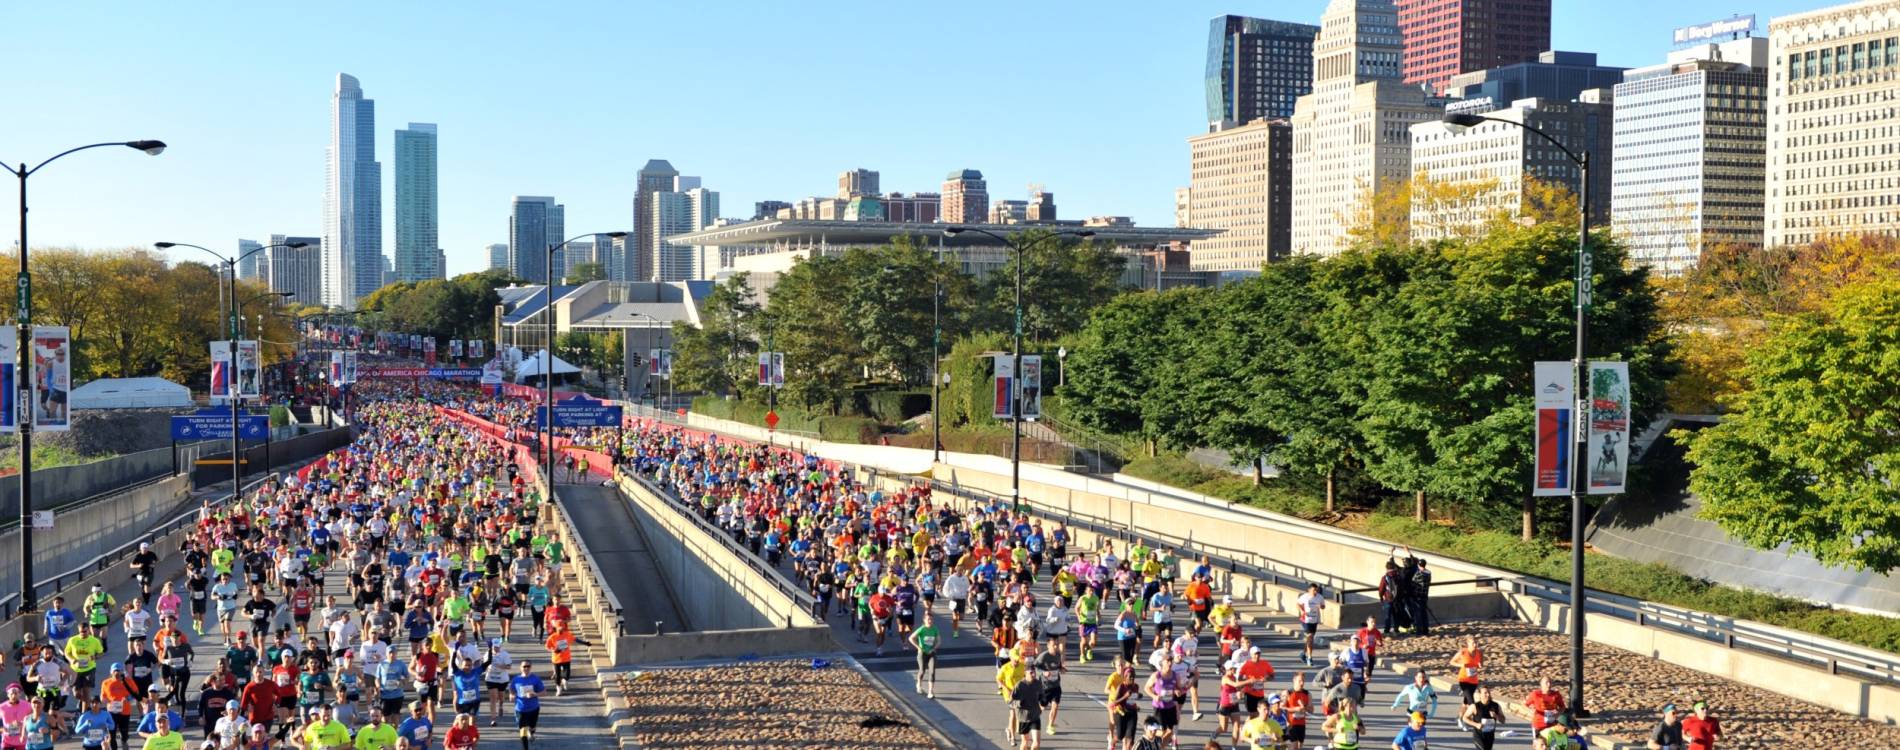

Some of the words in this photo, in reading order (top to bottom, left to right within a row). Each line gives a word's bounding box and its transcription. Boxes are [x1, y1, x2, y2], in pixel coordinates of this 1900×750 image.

[1446, 96, 1493, 111] MOTOROLA
[1582, 252, 1592, 305] C20N
[18, 277, 29, 319] C11N
[444, 368, 481, 376] MARATHON
